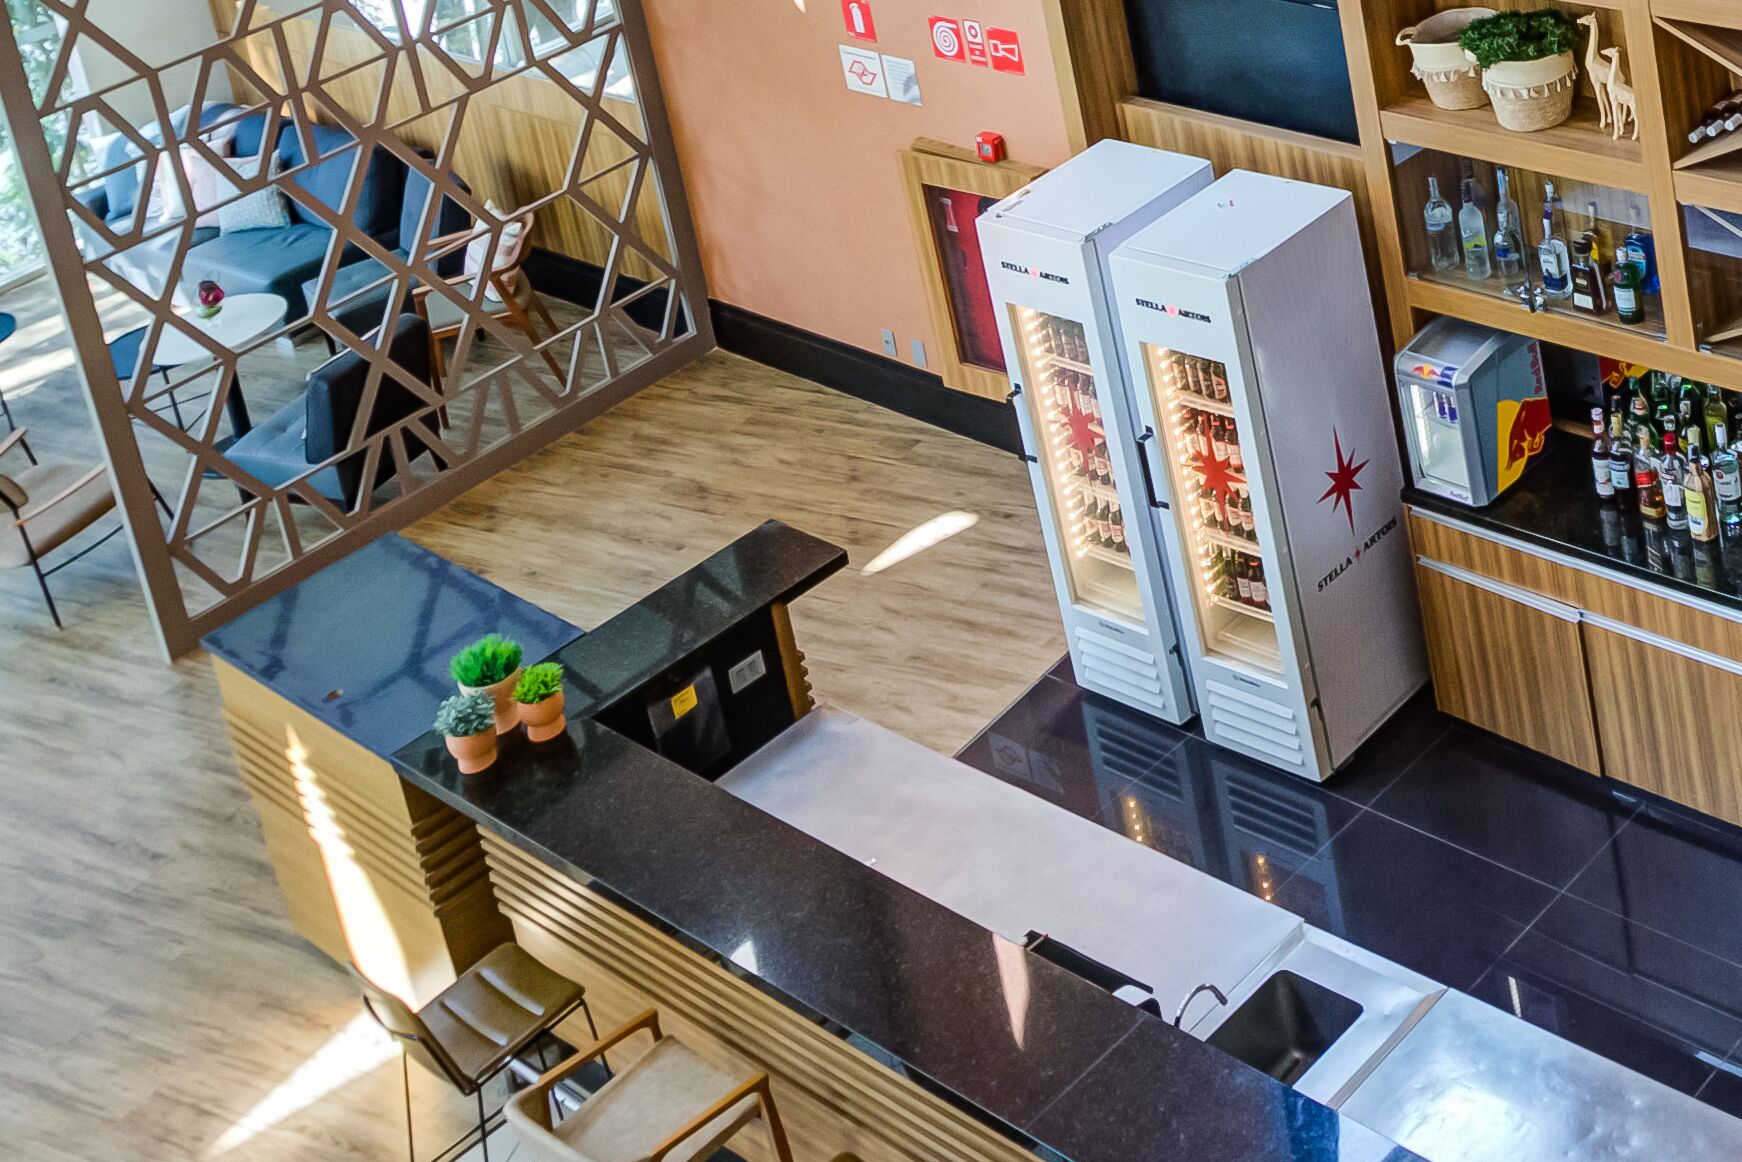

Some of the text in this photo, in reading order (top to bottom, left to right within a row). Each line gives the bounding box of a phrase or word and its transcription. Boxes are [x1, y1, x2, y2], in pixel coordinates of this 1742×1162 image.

[1001, 261, 1029, 274] STELLA
[1135, 298, 1212, 324] STELLA ARTOIS
[1317, 516, 1398, 592] STELLA ARTOIS
